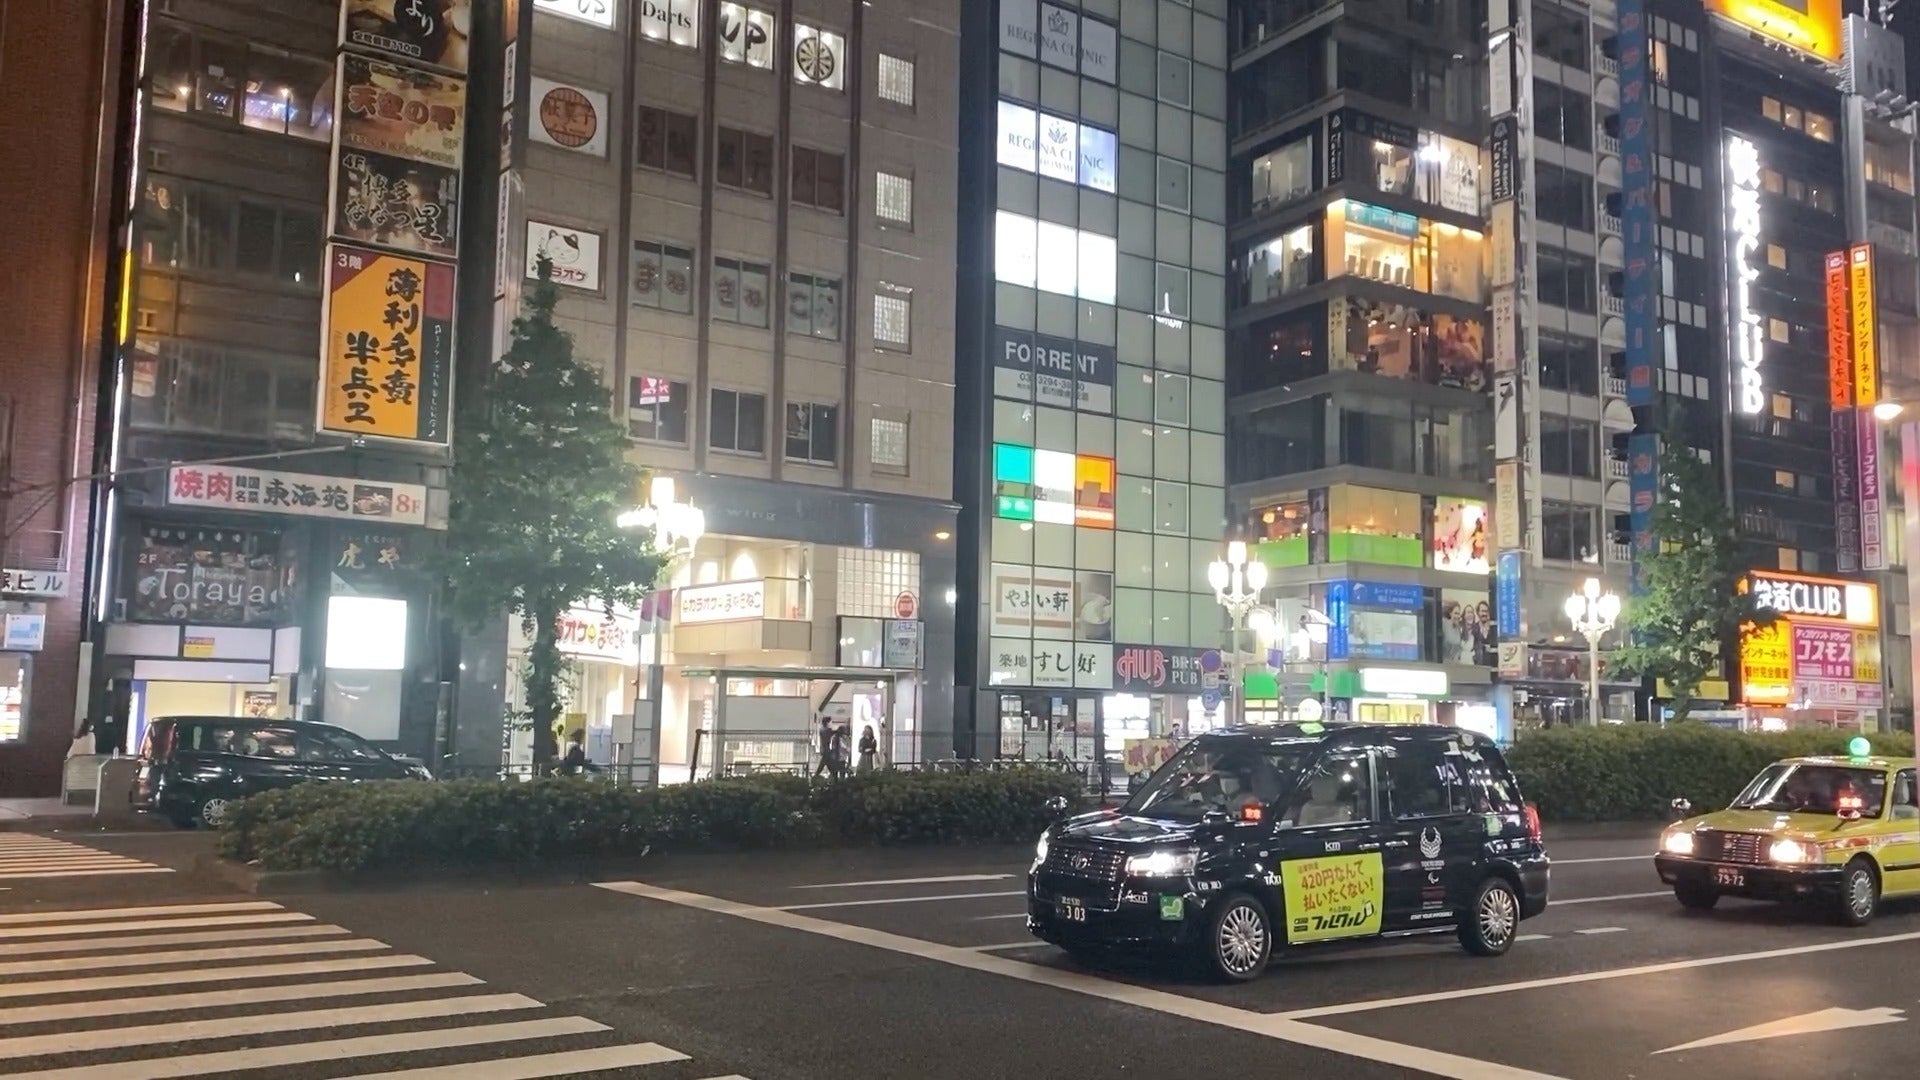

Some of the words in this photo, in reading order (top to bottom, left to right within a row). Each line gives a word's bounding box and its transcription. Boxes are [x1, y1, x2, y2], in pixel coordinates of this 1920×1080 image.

[642, 1, 692, 29] Darts
[549, 265, 587, 282] ラオケ
[1729, 136, 1763, 412] CLUB
[1005, 341, 1046, 367] FOR
[1049, 349, 1098, 375] RENT
[174, 469, 233, 501] 焼肉
[139, 553, 157, 564] 2F
[1005, 589, 1069, 613] やよい軒
[1797, 640, 1852, 662] コスモス
[1117, 648, 1166, 688] HUB
[1171, 671, 1198, 685] PUB
[1325, 842, 1340, 851] km
[1301, 860, 1364, 890] 420円なんて
[1303, 877, 1374, 911] 払いたくない!
